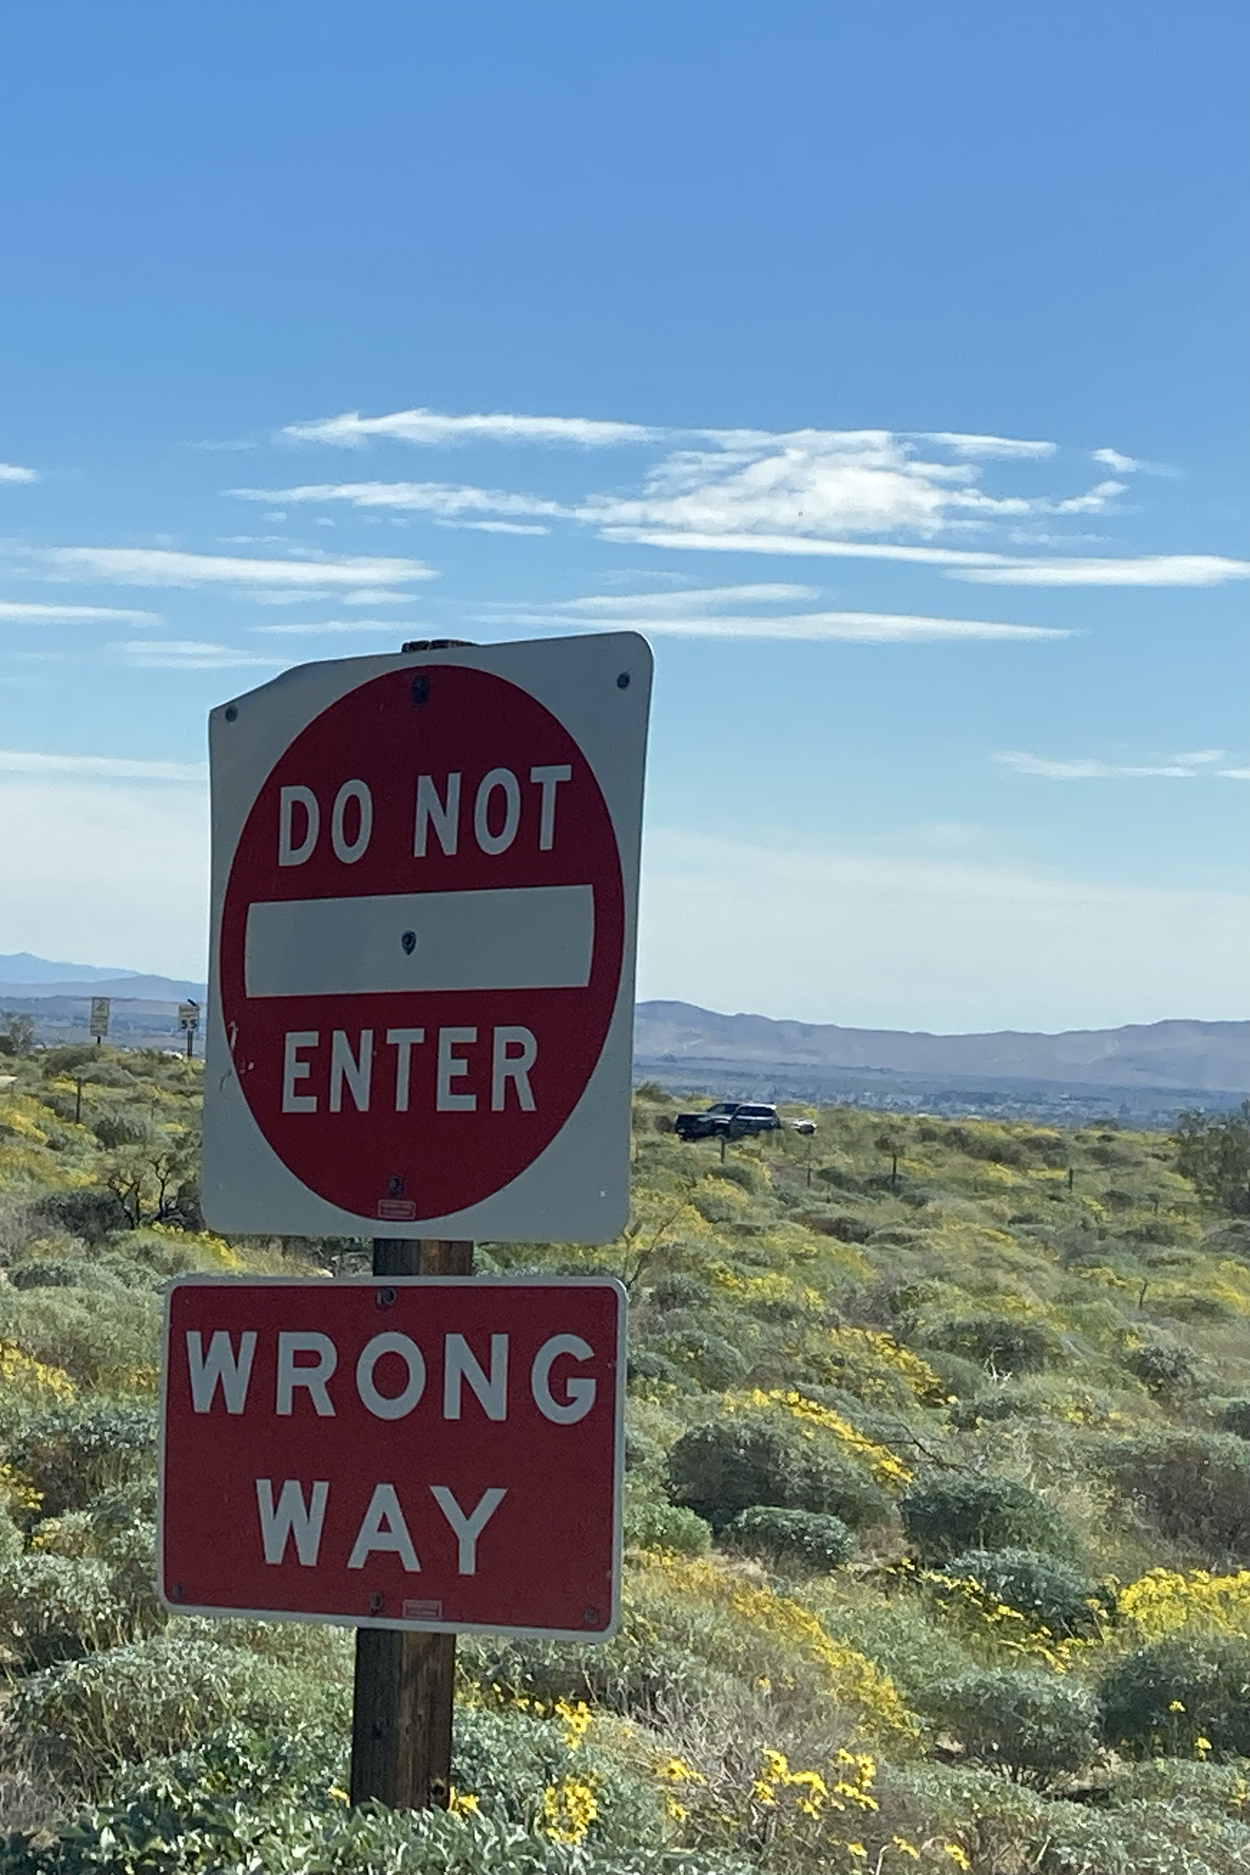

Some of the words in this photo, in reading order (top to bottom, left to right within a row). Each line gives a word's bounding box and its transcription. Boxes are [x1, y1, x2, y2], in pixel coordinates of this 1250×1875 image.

[279, 780, 372, 866] DO
[414, 765, 572, 857] NOT
[282, 1026, 537, 1112] ENTER
[186, 1331, 596, 1424] WRONG
[256, 1479, 507, 1575] WAY
